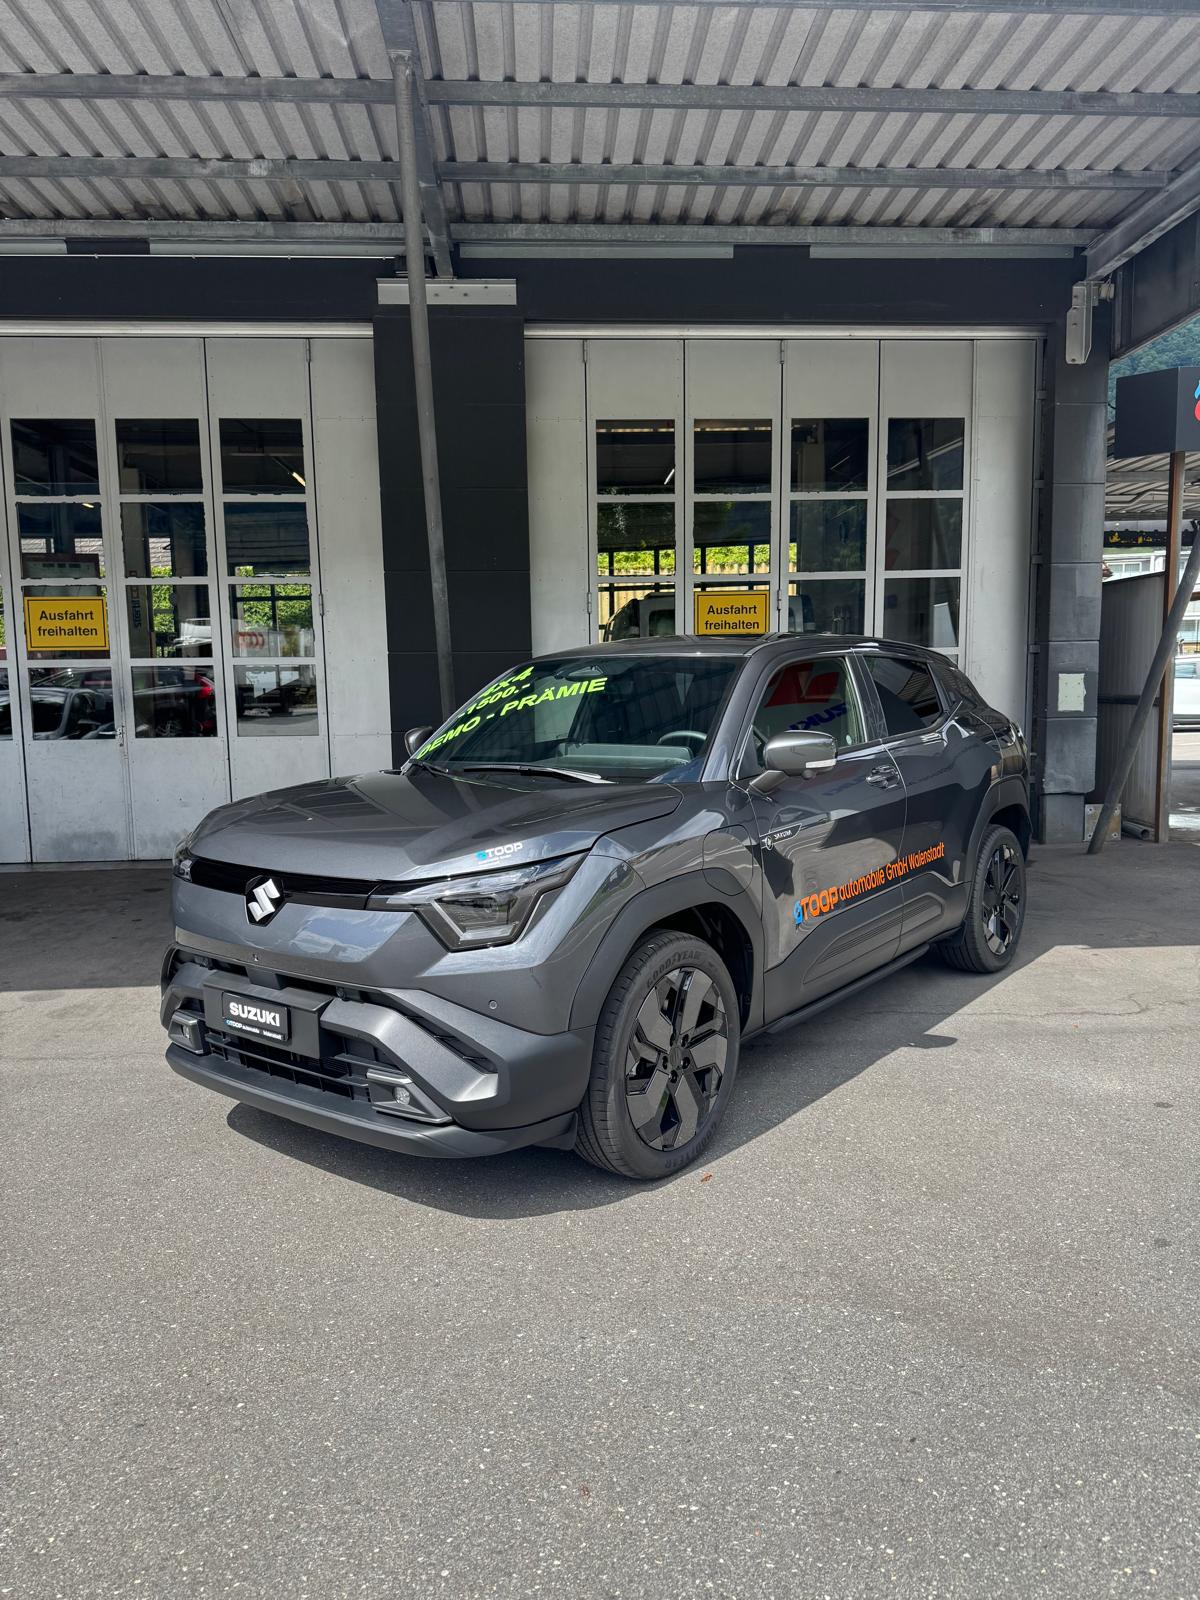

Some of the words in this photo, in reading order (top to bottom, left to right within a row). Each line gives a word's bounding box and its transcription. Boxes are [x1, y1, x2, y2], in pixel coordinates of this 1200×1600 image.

[707, 604, 757, 615] Ausfahrt
[39, 610, 94, 621] Ausfahrt
[705, 619, 759, 630] freihalten
[38, 625, 98, 636] freihalten
[416, 715, 481, 760] DEMO
[500, 677, 608, 717] PRÄMIE
[840, 868, 886, 901] automobile
[885, 858, 908, 881] GmbH
[908, 841, 945, 870] Walenstadt
[229, 1002, 280, 1027] SUZUKI
